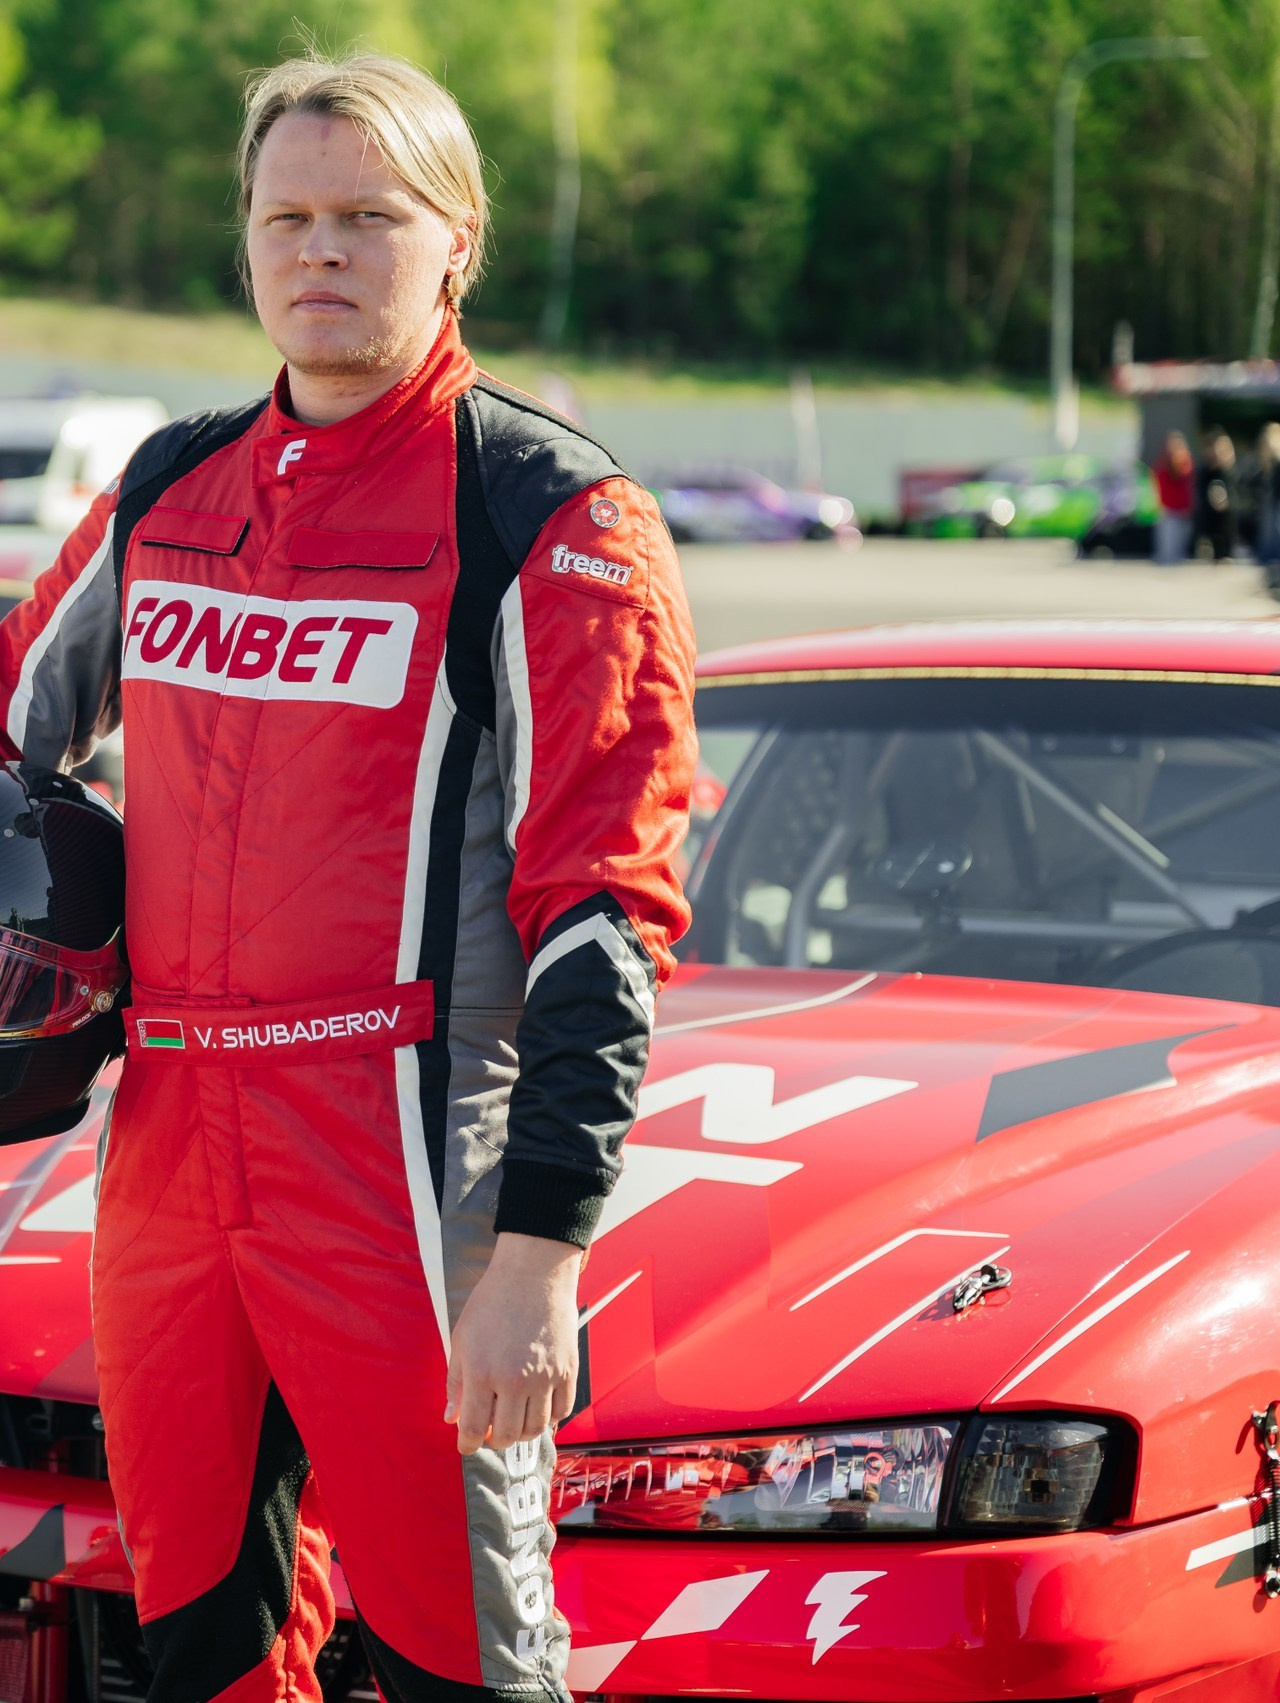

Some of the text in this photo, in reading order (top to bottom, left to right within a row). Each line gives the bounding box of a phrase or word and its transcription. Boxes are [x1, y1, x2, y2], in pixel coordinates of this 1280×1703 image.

[276, 439, 307, 476] F
[551, 544, 634, 586] freem
[123, 597, 394, 685] FONBET
[193, 1005, 402, 1050] V. SHUBADEROV
[505, 1434, 546, 1661] FONBE
